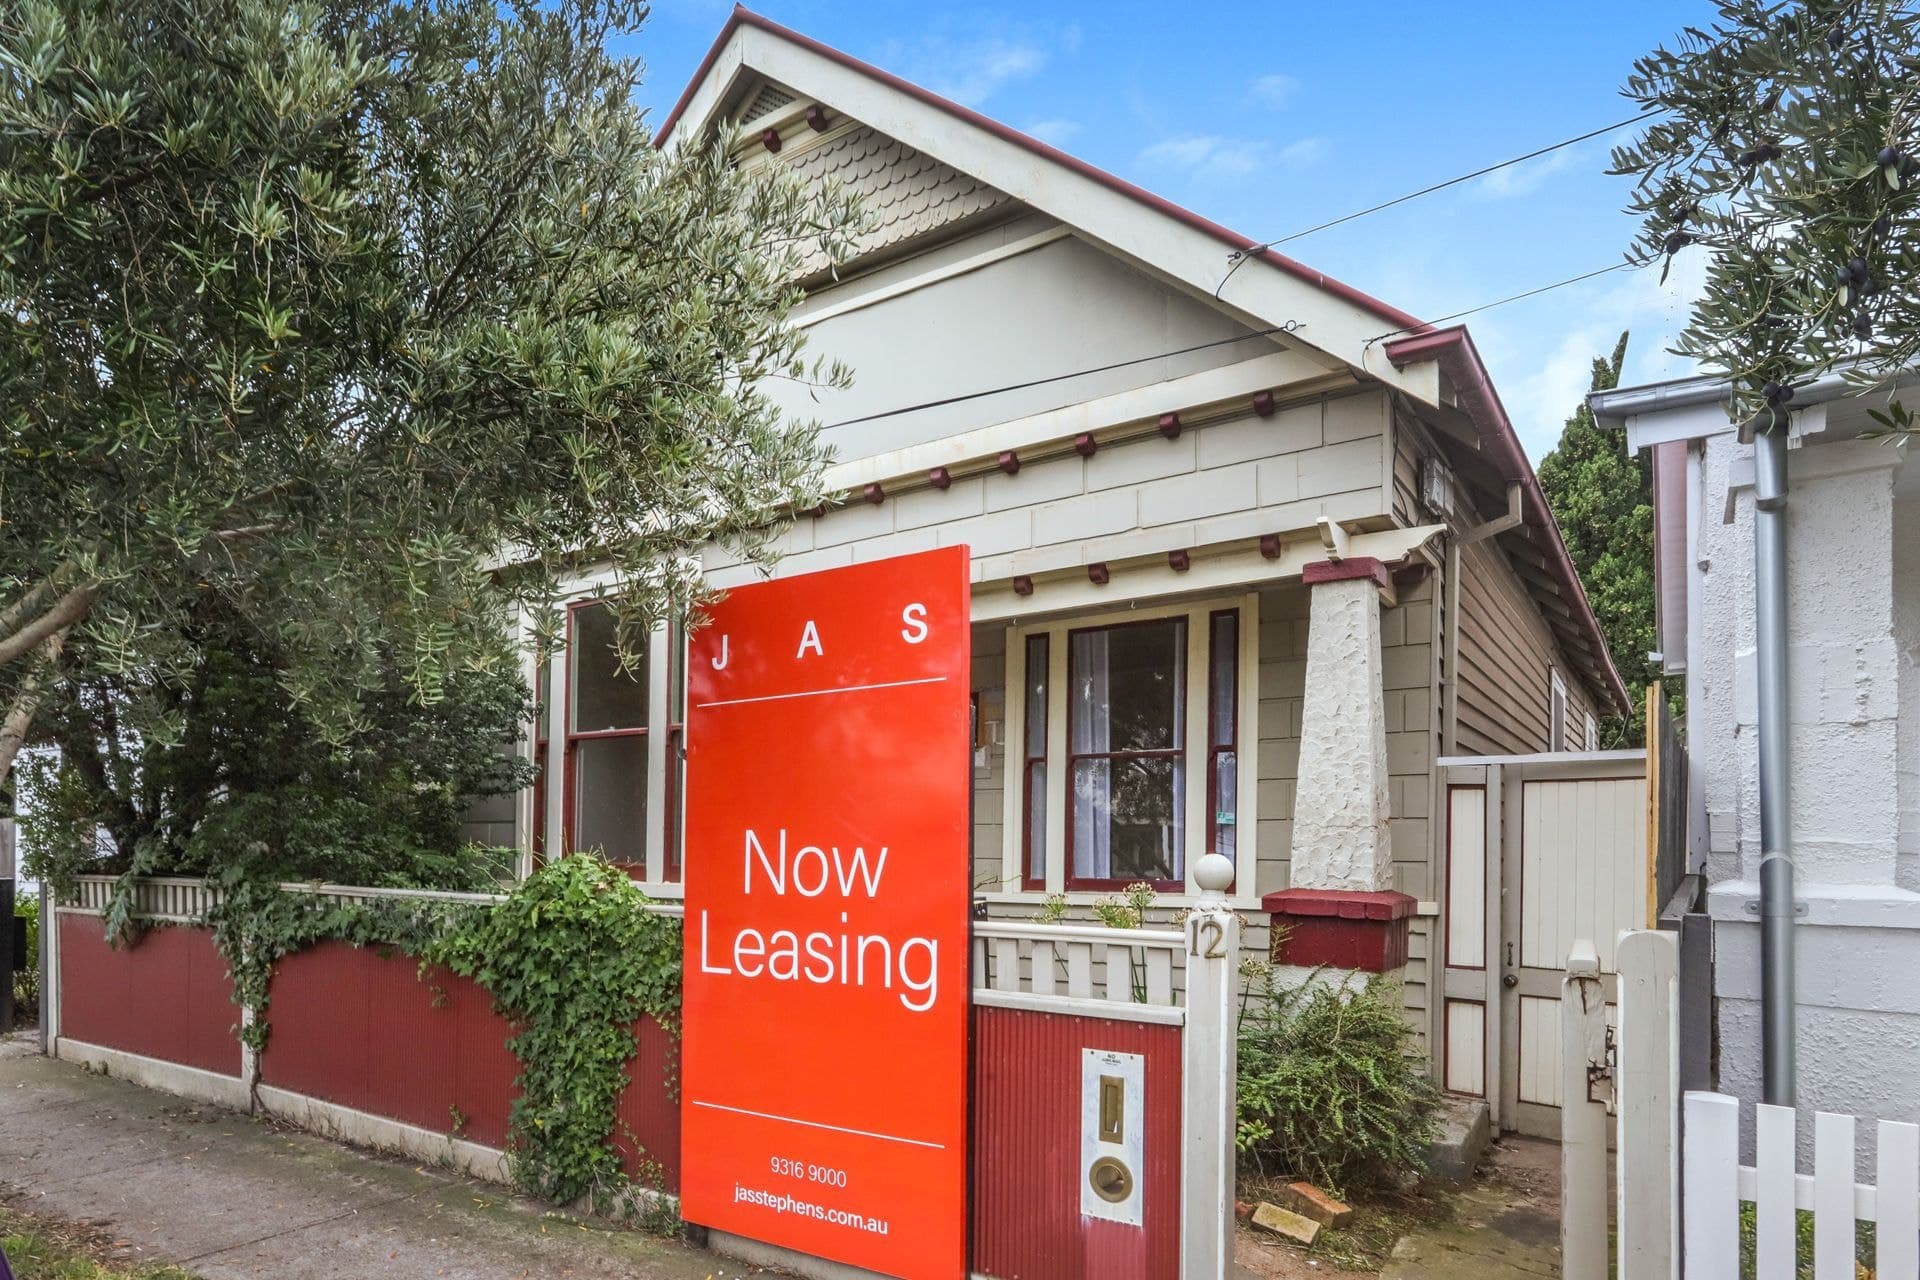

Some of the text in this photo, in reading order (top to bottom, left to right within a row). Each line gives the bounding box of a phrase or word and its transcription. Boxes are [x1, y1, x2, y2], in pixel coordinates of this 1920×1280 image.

[744, 829, 888, 897] Now
[701, 910, 938, 1012] Leasing
[1190, 919, 1227, 960] 12
[771, 1156, 847, 1188] 9316 9000
[734, 1181, 888, 1235] jasstephens.com.au
